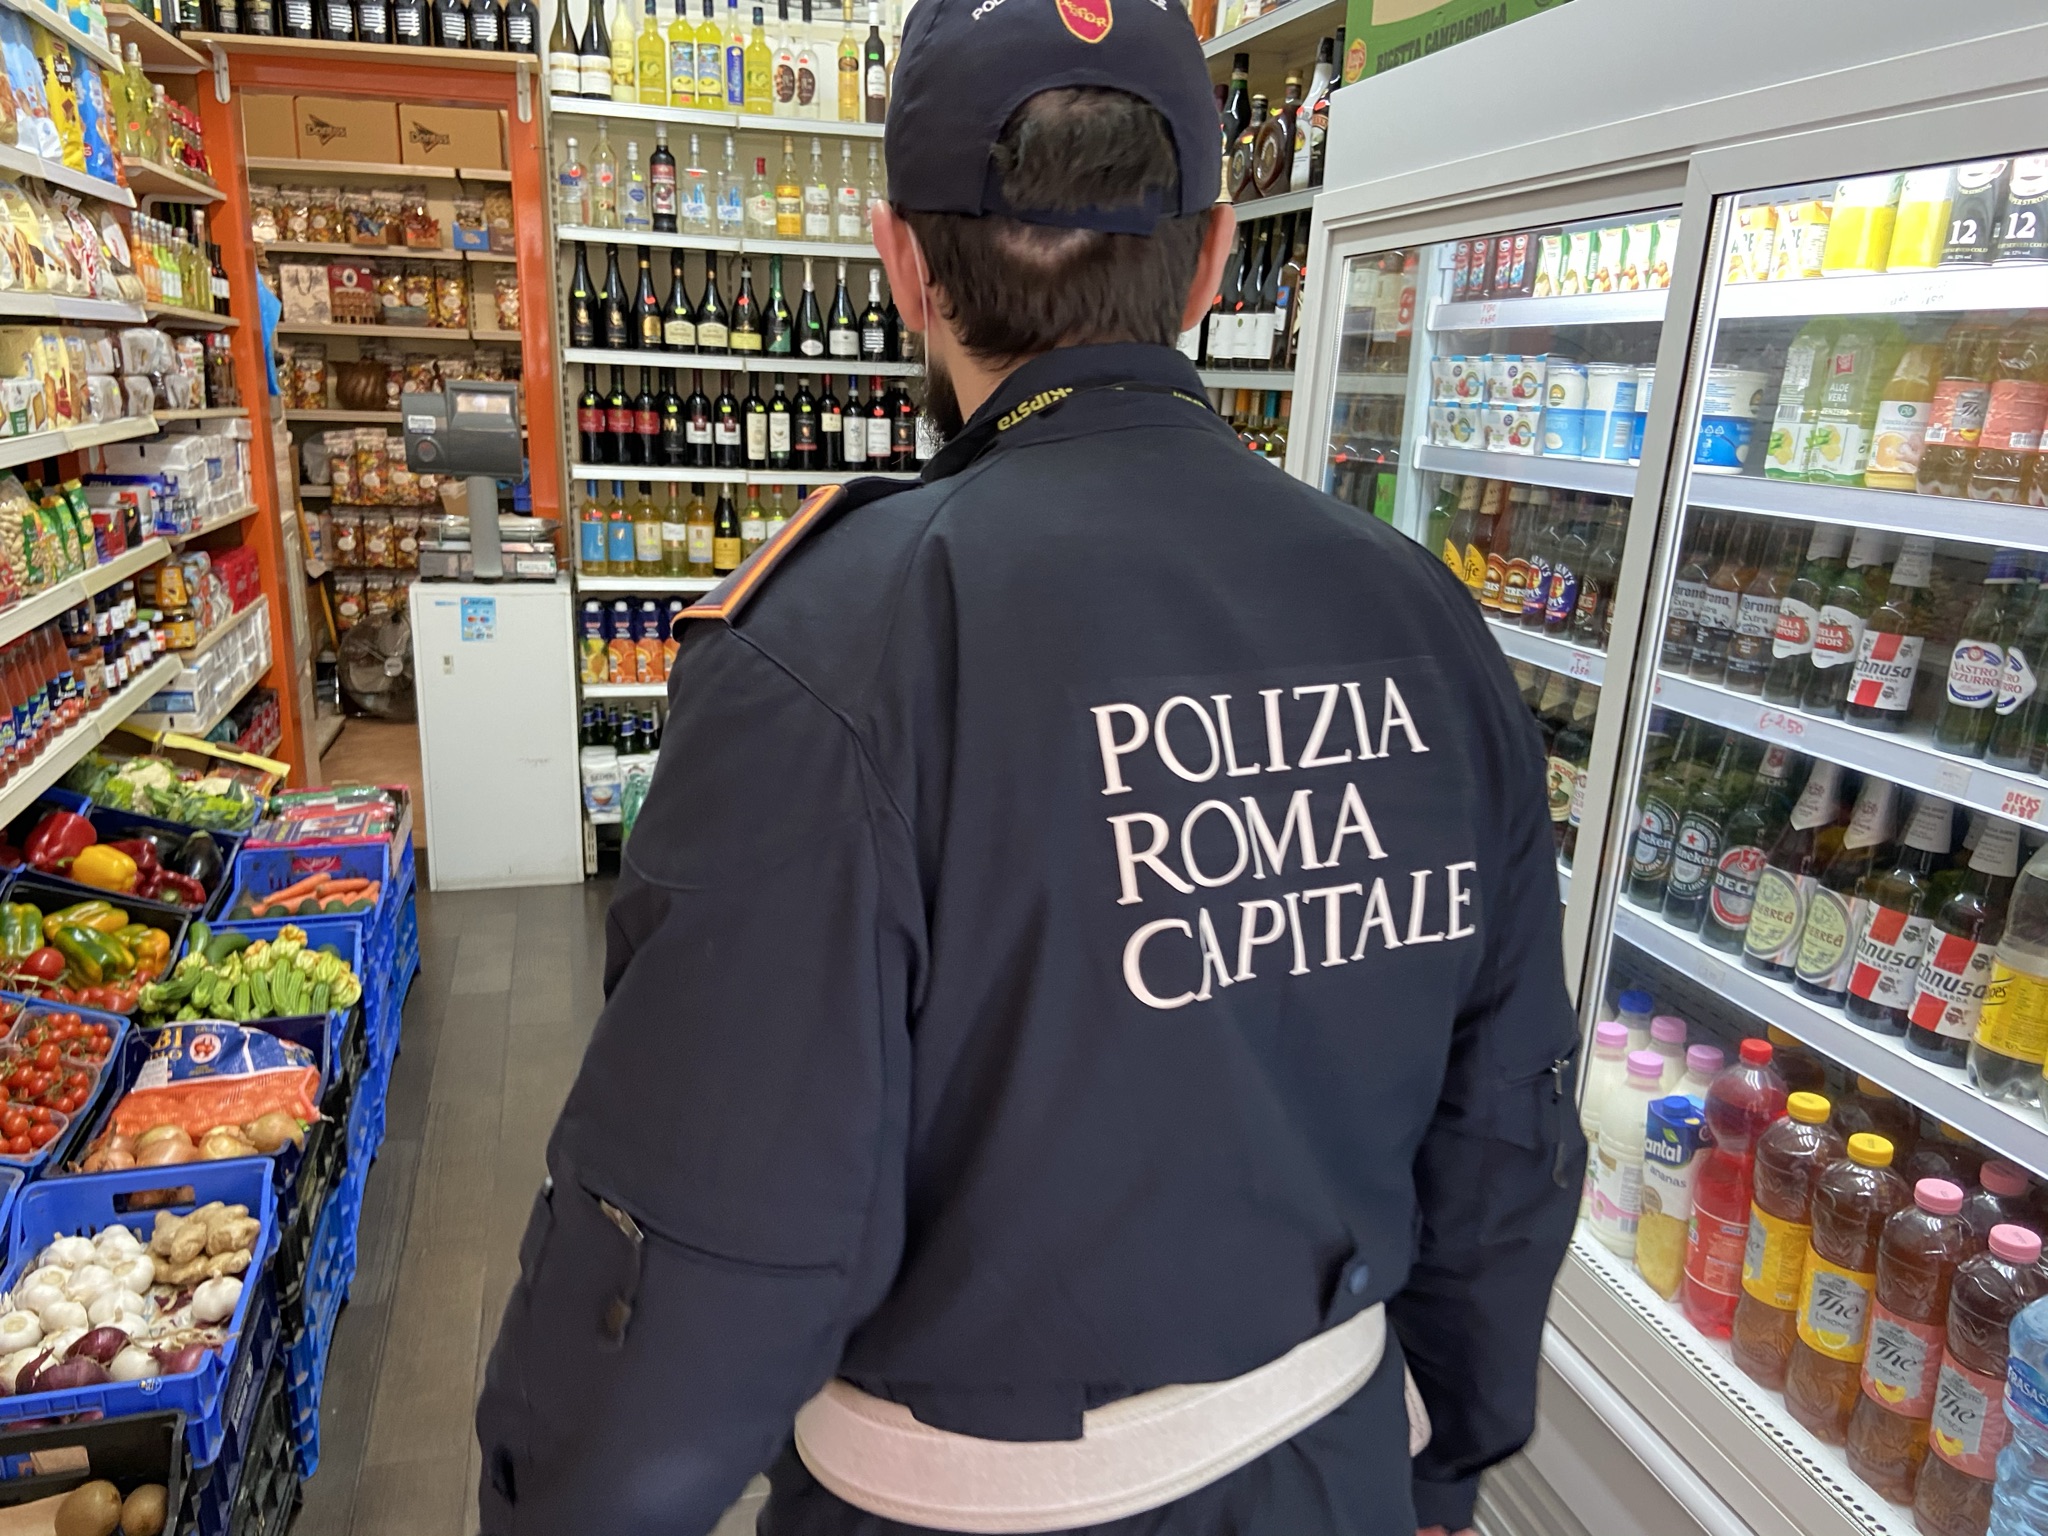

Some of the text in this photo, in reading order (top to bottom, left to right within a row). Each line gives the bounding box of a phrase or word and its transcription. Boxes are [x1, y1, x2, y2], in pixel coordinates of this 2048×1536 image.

[971, 0, 1007, 21] POL
[1376, 4, 1507, 74] RICETTA CAMPAGNOLA
[305, 123, 347, 138] Doritos
[409, 130, 450, 145] Doritos
[1948, 219, 1977, 245] 12
[2004, 211, 2037, 239] 12
[1827, 393, 1848, 402] VERA
[1828, 383, 1850, 393] ALOE
[1855, 656, 1913, 679] chnusa
[1953, 660, 1998, 677] NASTRO
[1089, 677, 1430, 795] POLIZIA
[2006, 791, 2041, 813] BECKS
[1106, 782, 1388, 905] ROMA
[1122, 861, 1477, 1010] CAPITALE
[1856, 932, 1922, 971] chnusa
[1917, 958, 1988, 1000] chnusa
[1645, 1137, 1683, 1163] antal
[1650, 1166, 1687, 1188] ananas
[1876, 1361, 1907, 1383] PESCA
[2007, 1366, 2048, 1409] FRASAS
